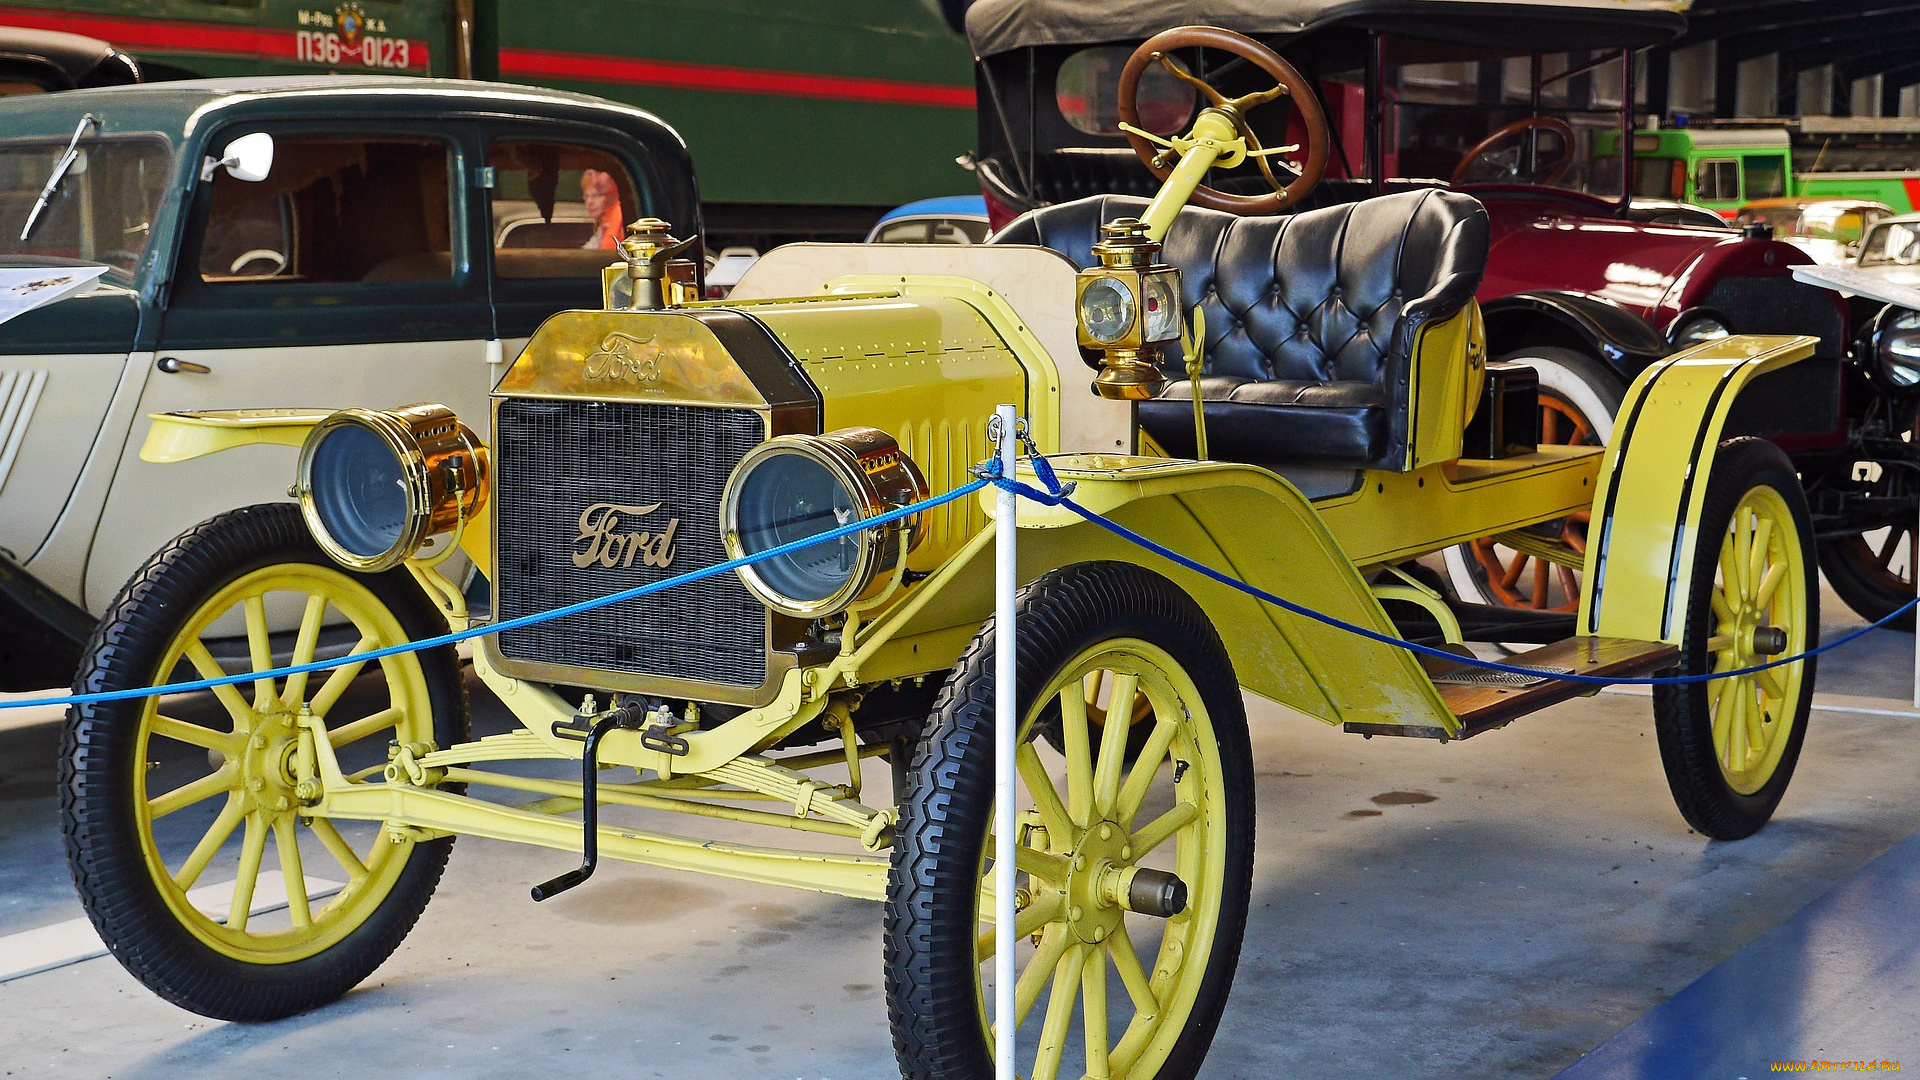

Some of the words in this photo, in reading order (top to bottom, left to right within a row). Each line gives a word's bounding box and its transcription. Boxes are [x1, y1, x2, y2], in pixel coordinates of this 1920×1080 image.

[362, 35, 409, 69] 0123
[583, 331, 665, 382] Ford
[572, 501, 680, 569] Ford
